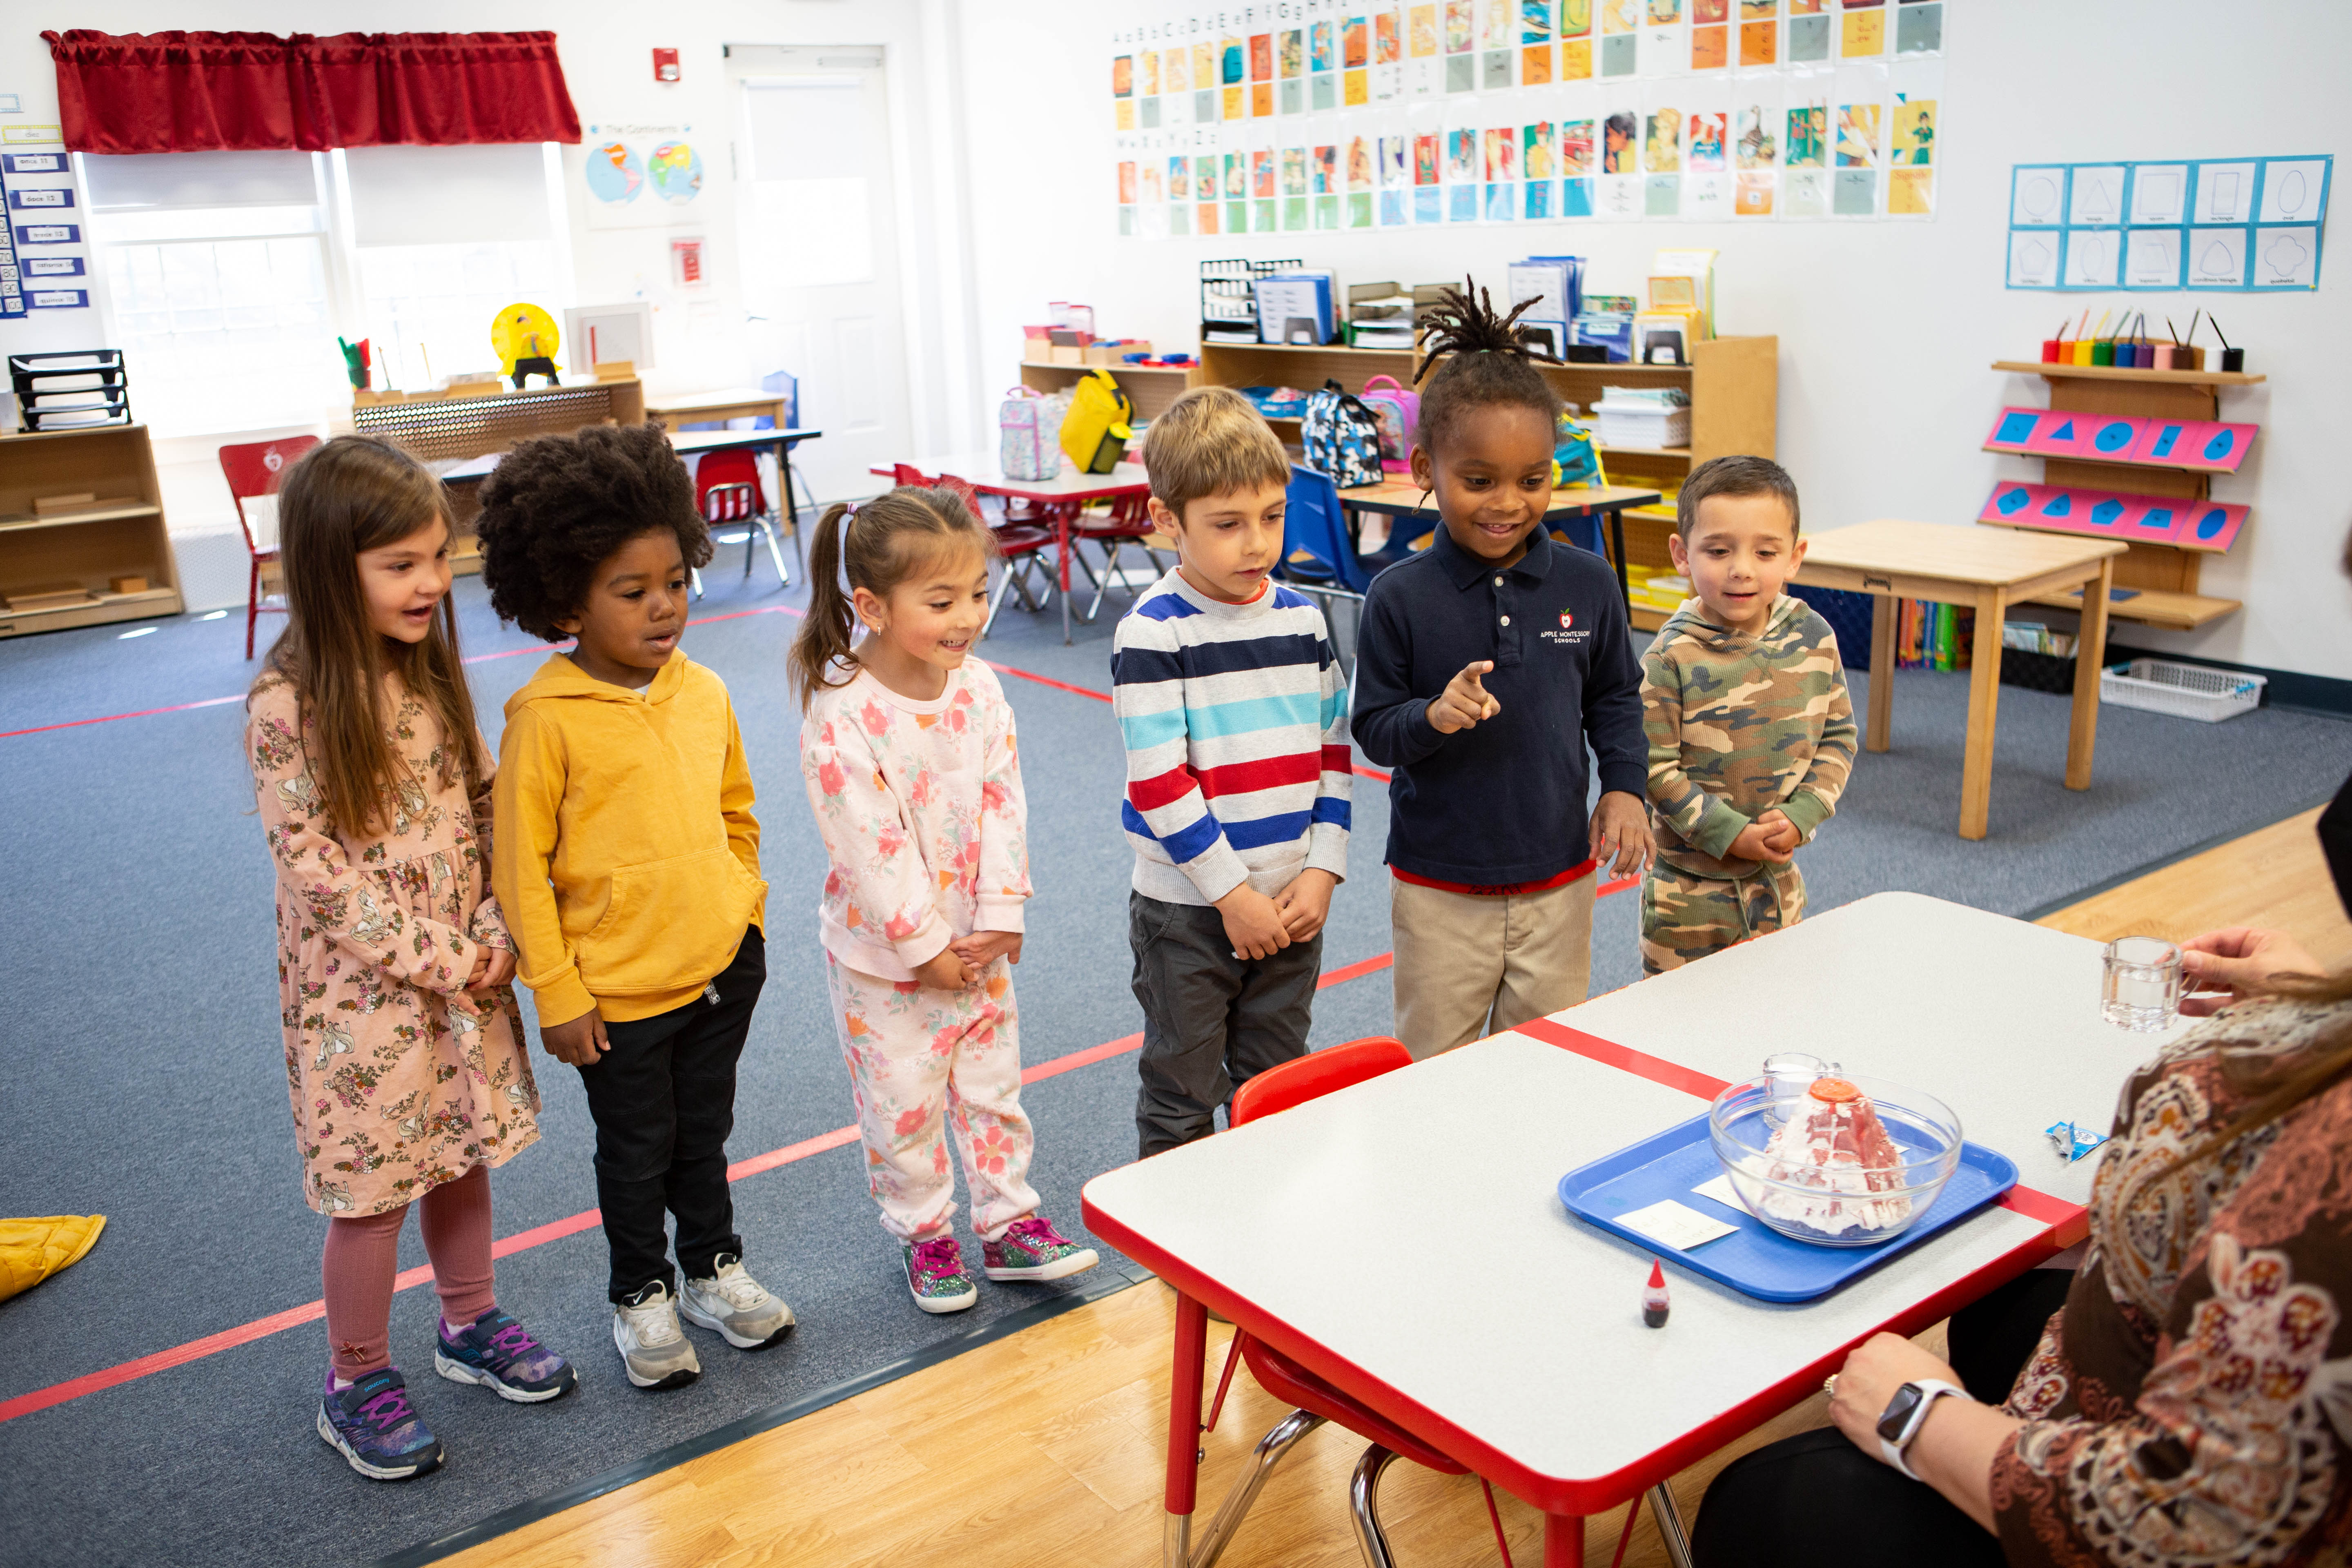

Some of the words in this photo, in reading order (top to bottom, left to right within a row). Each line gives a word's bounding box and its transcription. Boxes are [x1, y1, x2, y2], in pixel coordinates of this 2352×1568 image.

[0, 253, 12, 262] 70
[2, 268, 17, 277] 80
[3, 284, 18, 293] 90
[7, 301, 22, 310] 100
[364, 1377, 389, 1392] saucony
